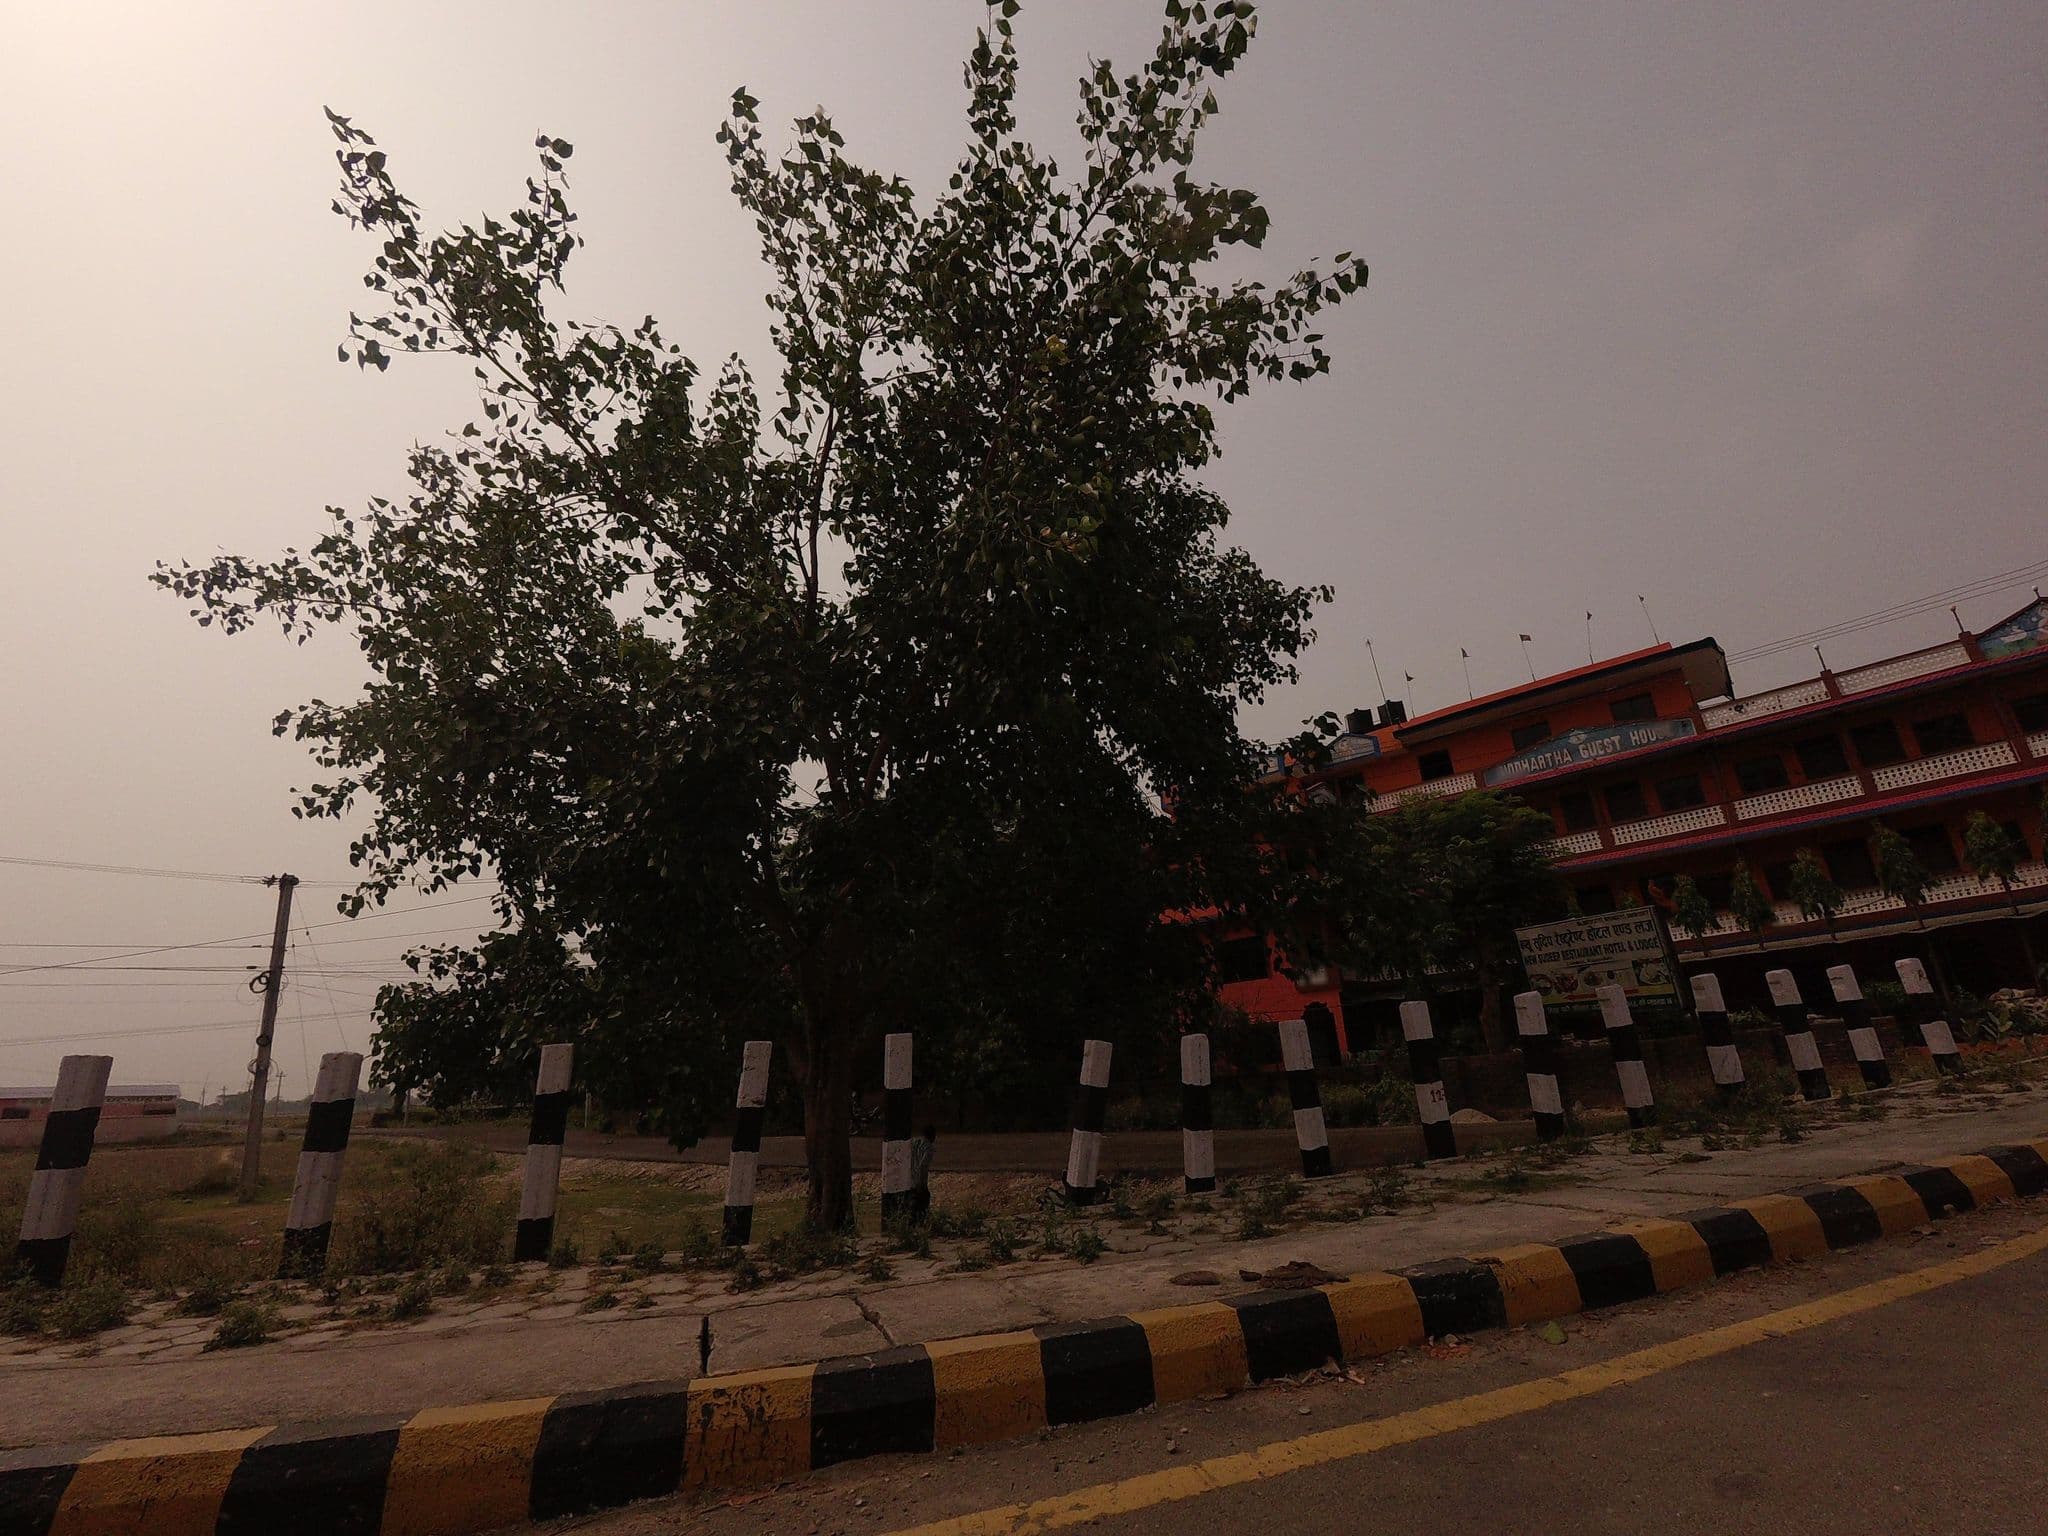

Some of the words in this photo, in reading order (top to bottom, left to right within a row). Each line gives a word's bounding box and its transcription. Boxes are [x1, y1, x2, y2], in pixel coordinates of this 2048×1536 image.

[1499, 749, 1573, 775] IDDHARTHA
[1579, 735, 1622, 759] GUEST
[1604, 941, 1626, 955] HOTEL
